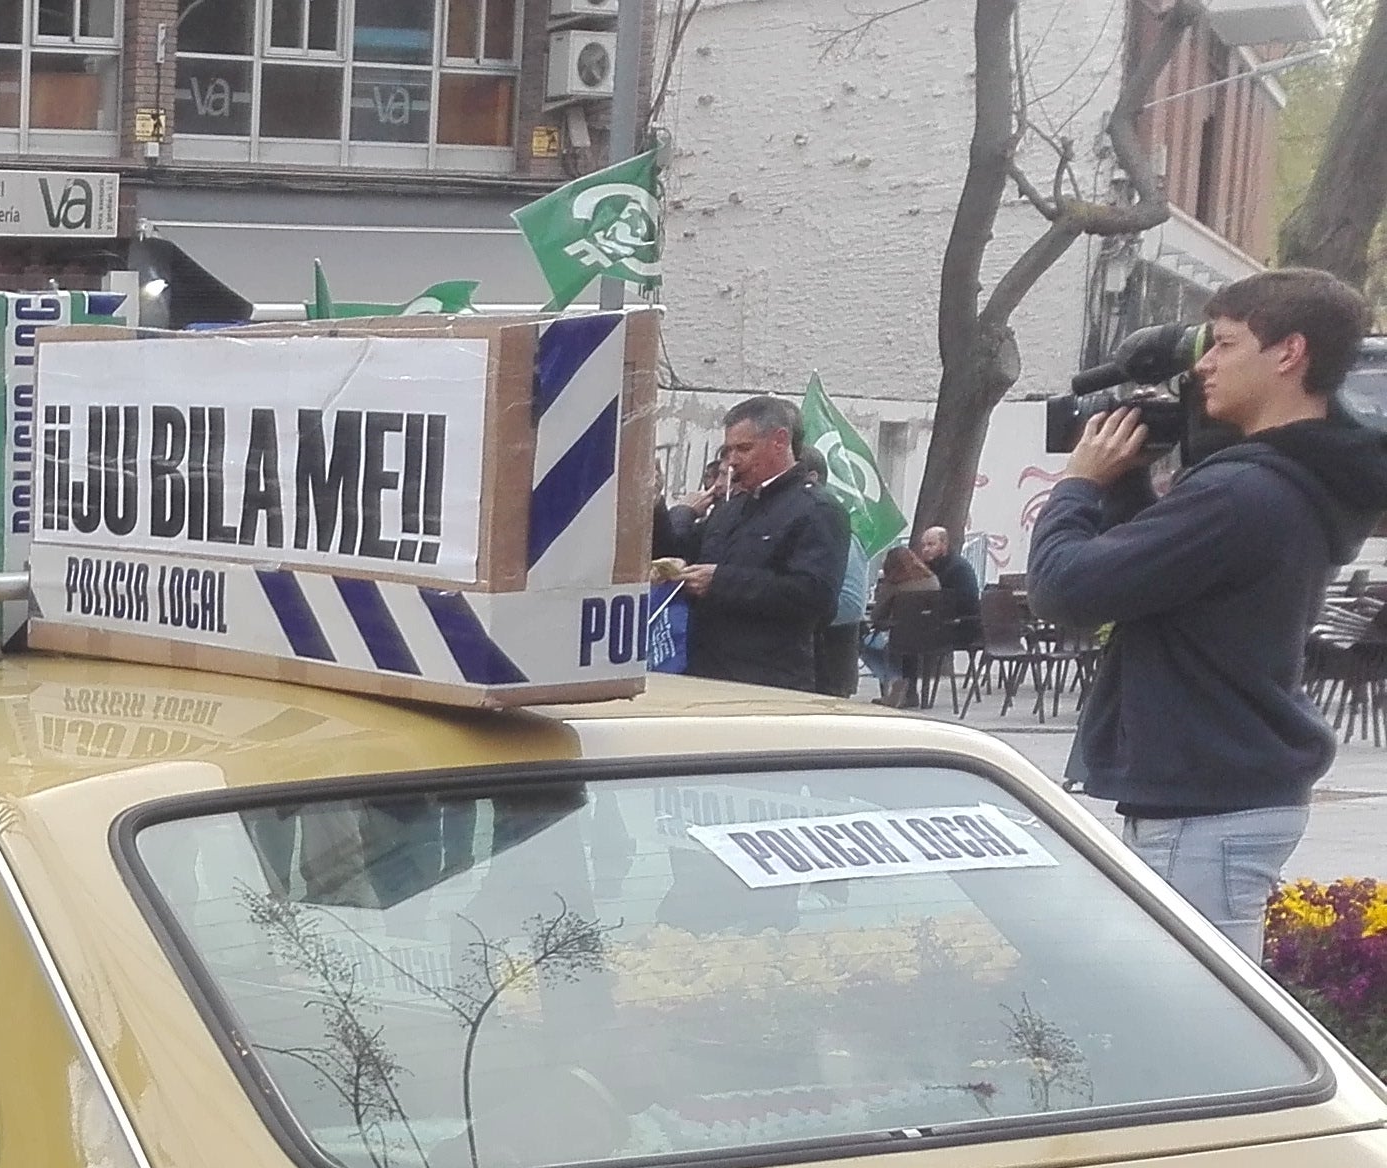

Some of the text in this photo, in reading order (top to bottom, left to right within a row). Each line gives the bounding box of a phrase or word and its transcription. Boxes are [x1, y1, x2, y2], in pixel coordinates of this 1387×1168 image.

[65, 555, 228, 634] POLICIA LOCAL
[727, 814, 1029, 876] POLICIA LOCAL
